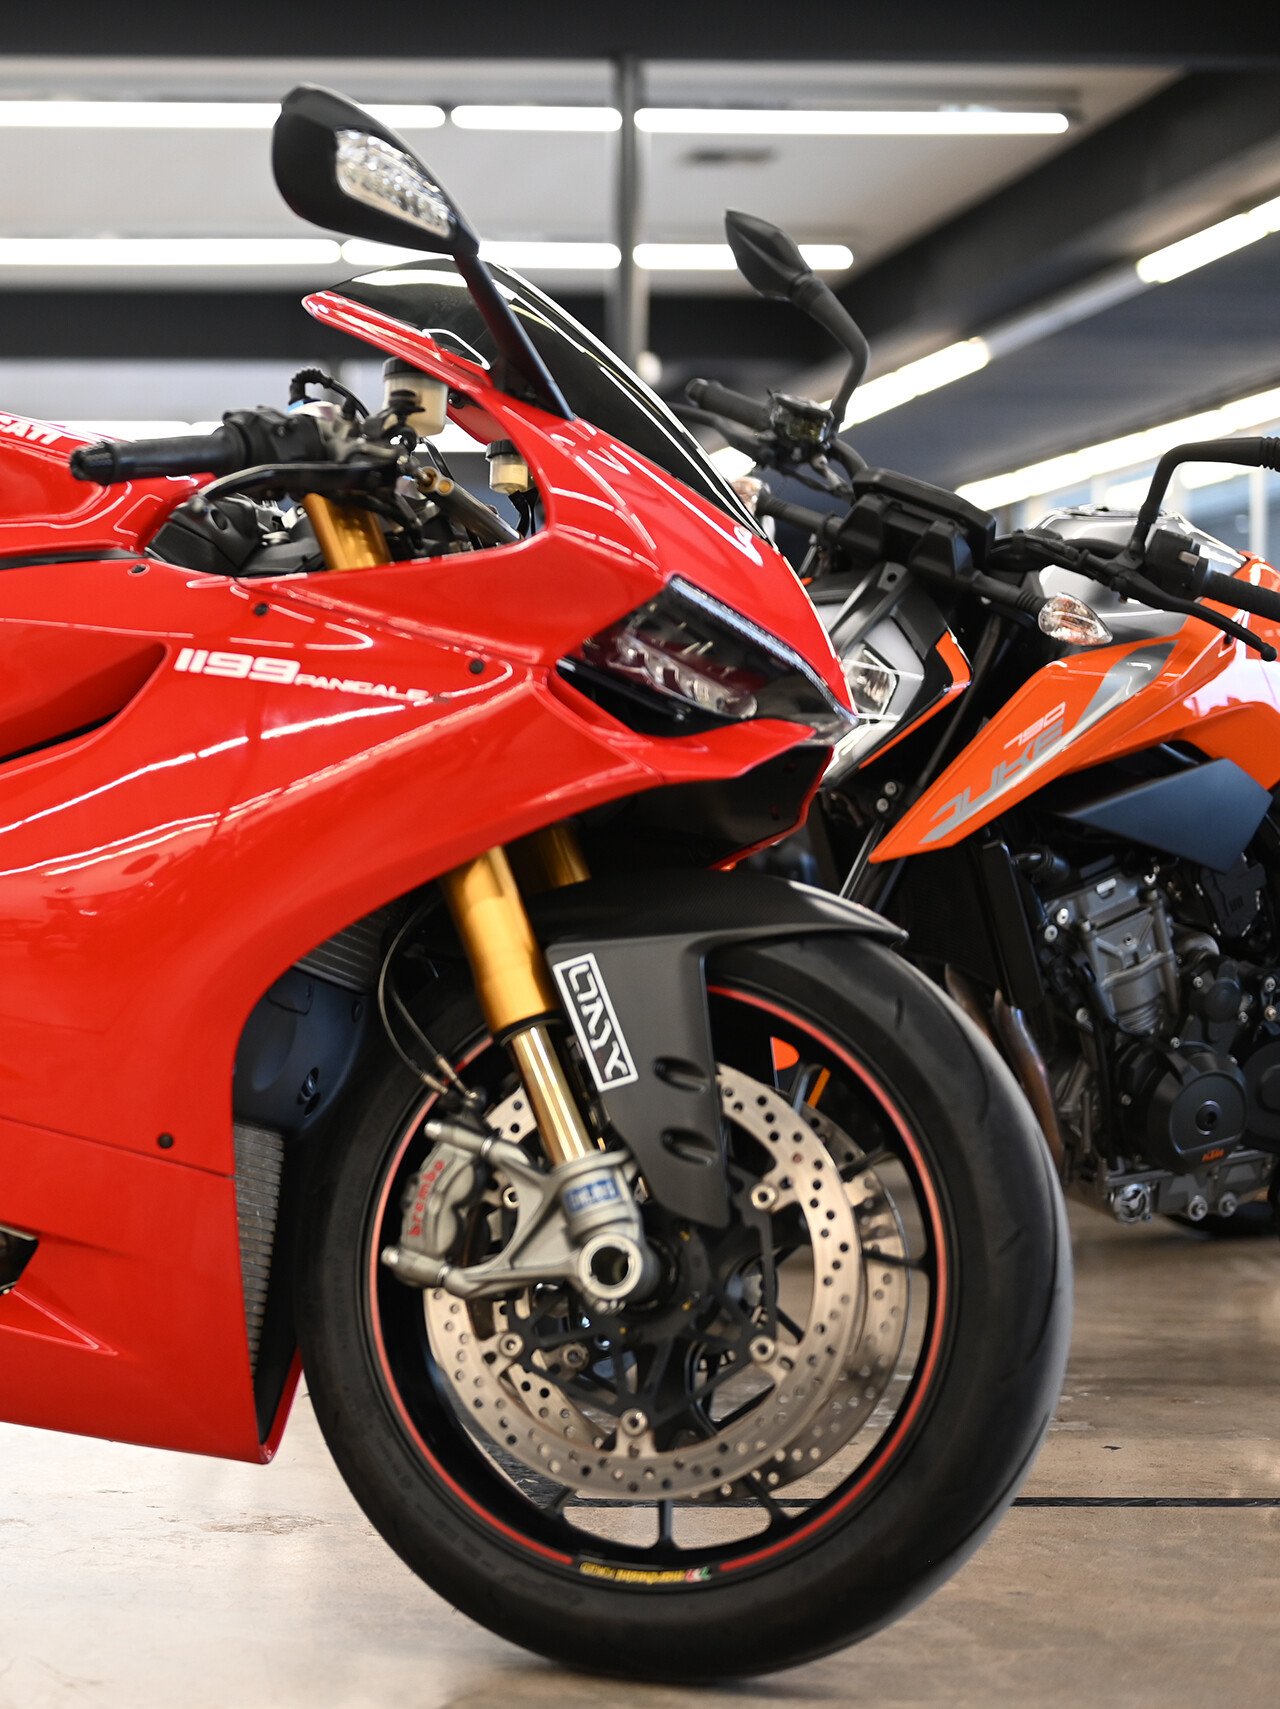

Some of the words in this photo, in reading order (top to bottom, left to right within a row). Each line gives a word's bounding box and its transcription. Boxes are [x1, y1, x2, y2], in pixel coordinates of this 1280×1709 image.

[173, 647, 301, 685] 1199
[295, 673, 430, 702] PANIGALE
[1003, 700, 1067, 750] 790
[920, 717, 1066, 844] DUKE
[408, 1160, 446, 1237] brembo
